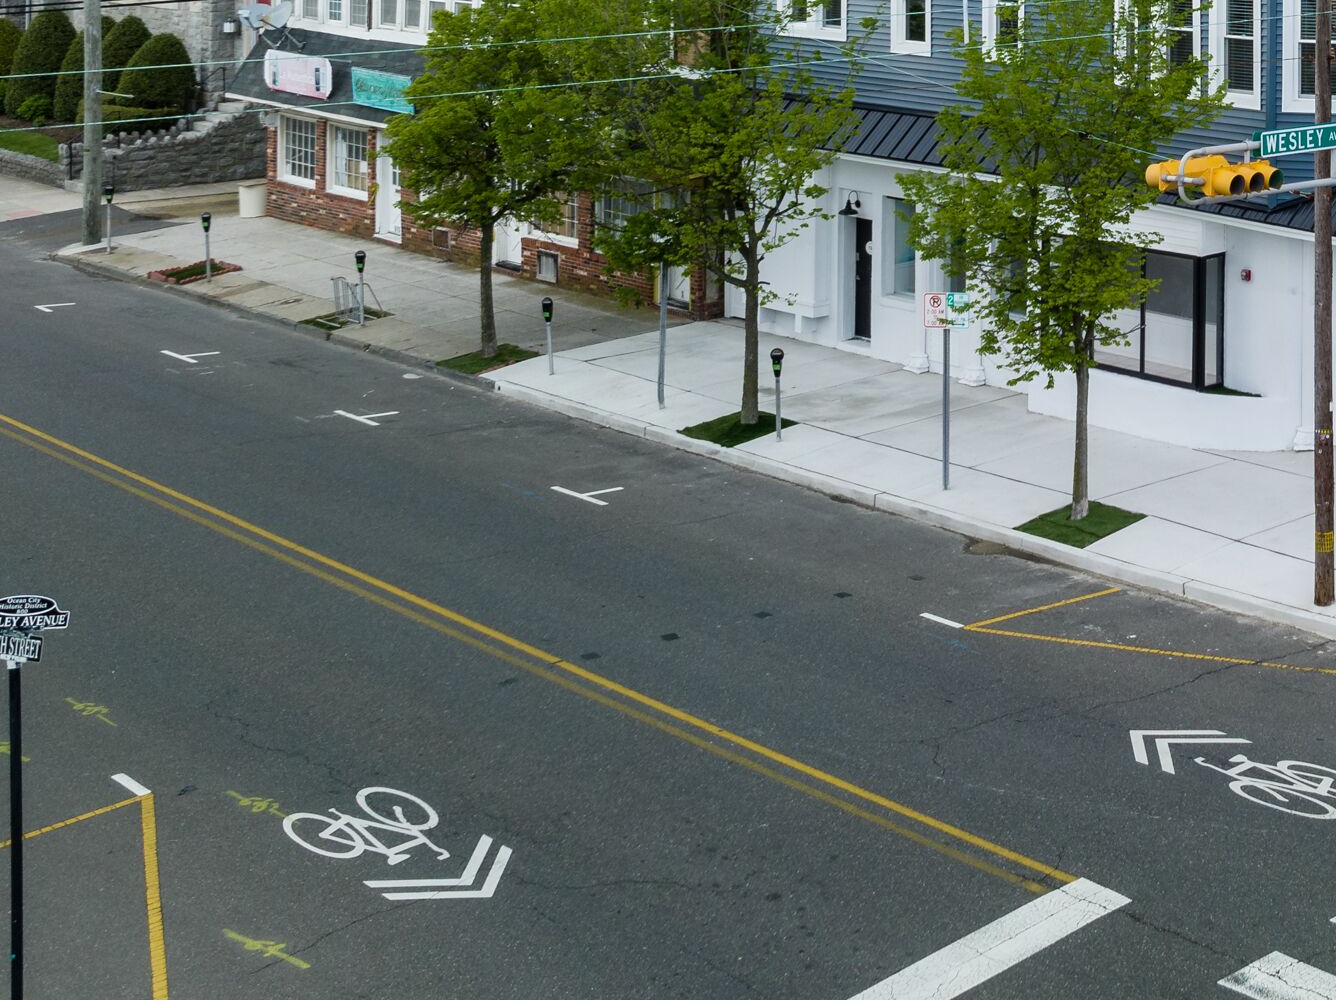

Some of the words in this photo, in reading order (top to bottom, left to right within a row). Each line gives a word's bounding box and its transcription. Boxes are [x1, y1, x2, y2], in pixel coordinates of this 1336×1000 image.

[1266, 129, 1323, 153] WESLEY
[947, 295, 954, 304] 2
[0, 616, 20, 627] LEY
[20, 614, 66, 626] AVENUE
[0, 635, 8, 654] H
[9, 637, 41, 658] STREET
